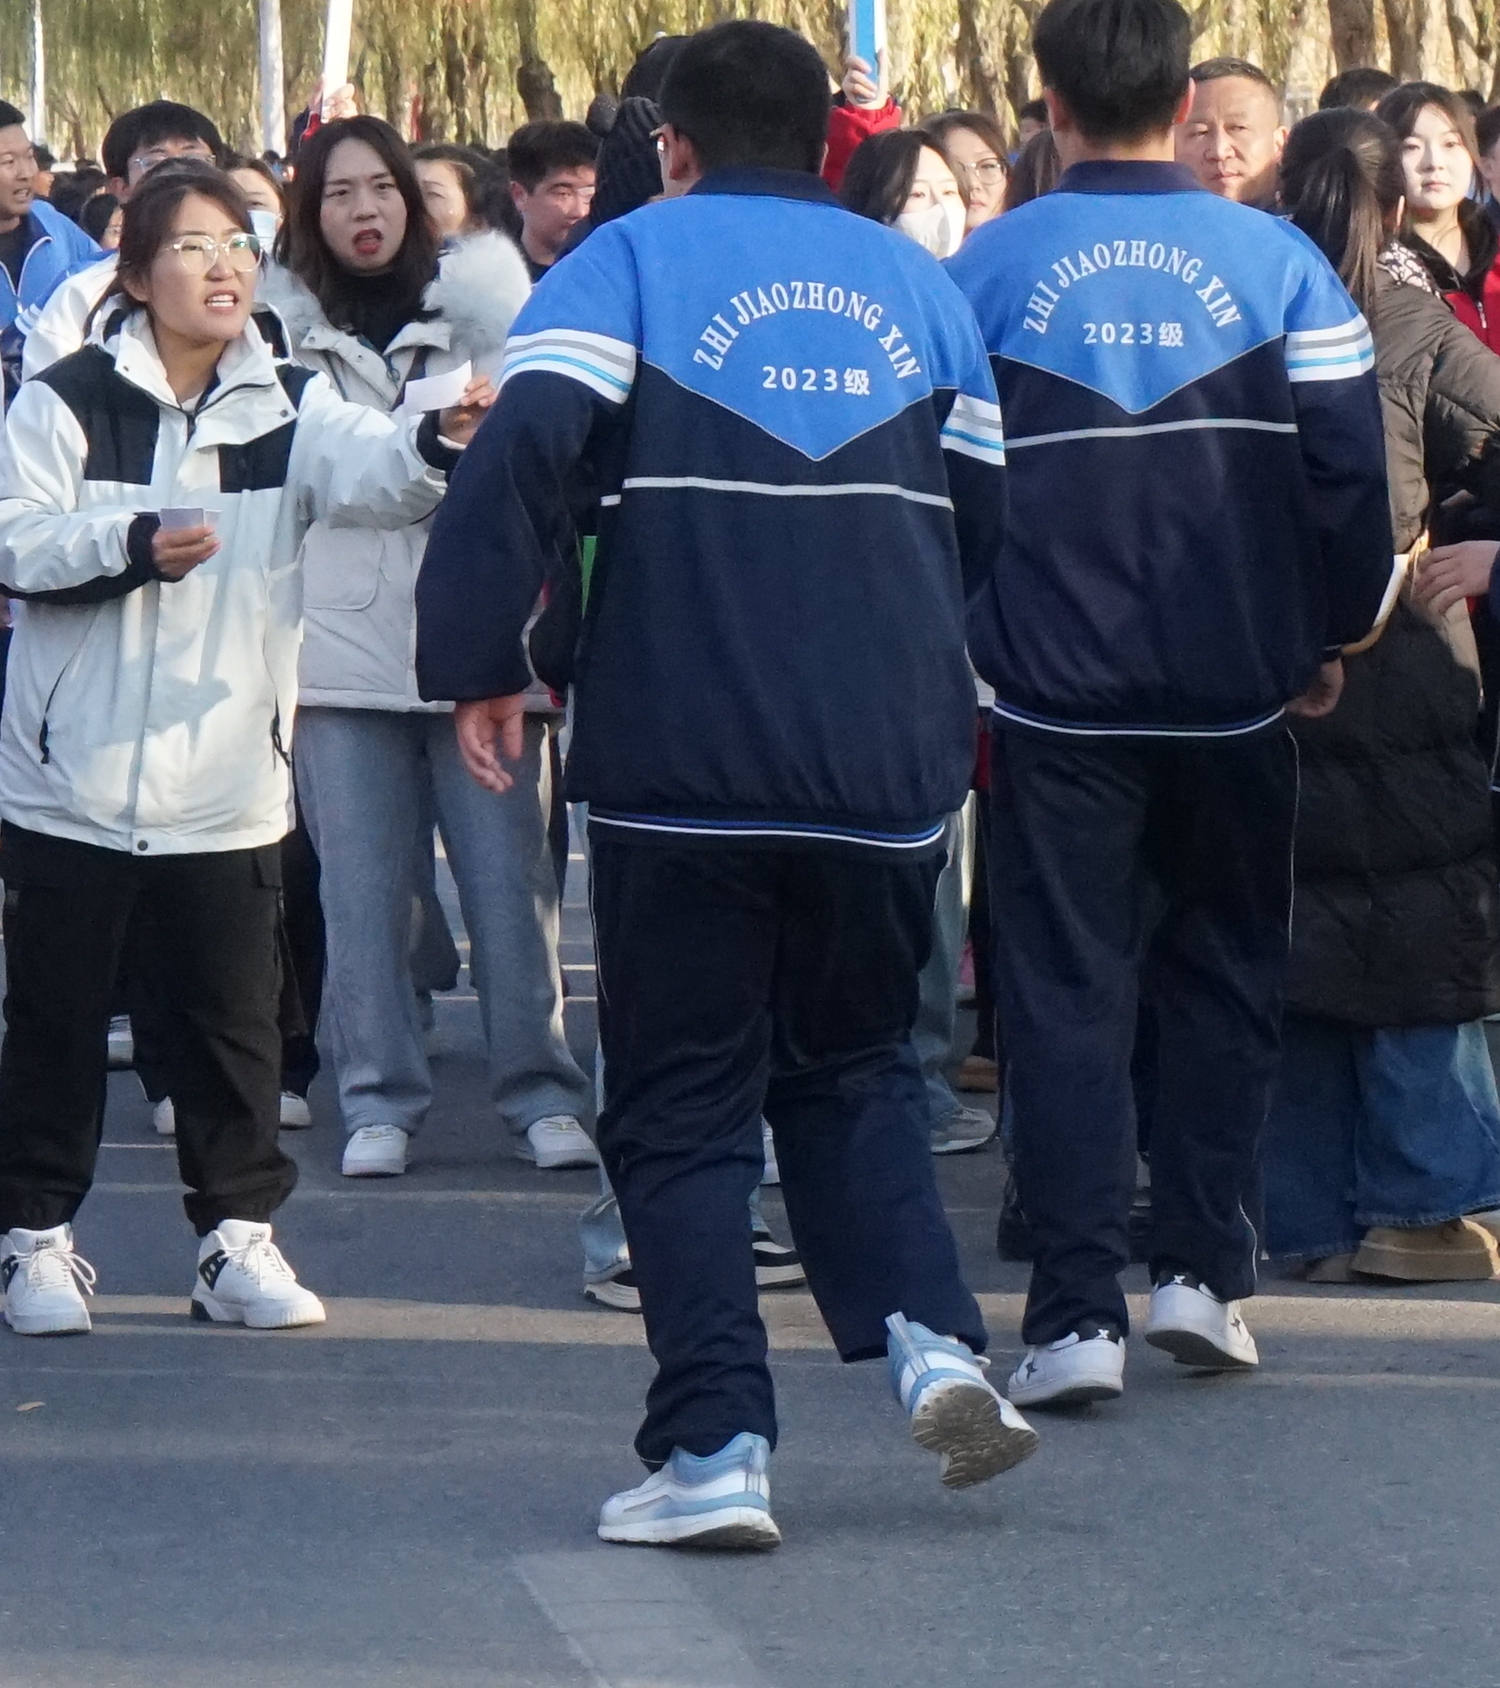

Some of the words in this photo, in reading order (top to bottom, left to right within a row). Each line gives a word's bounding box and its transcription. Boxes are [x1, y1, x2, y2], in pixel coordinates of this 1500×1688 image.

[1023, 280, 1060, 335] ZHI
[1051, 240, 1204, 288] JIAOZHONG
[1195, 274, 1242, 328] XIN
[692, 313, 739, 371] ZHI
[729, 281, 884, 332] JIAOZHONG
[877, 324, 922, 379] XIN
[1082, 321, 1185, 348] 2023级
[762, 365, 871, 396] 2023级
